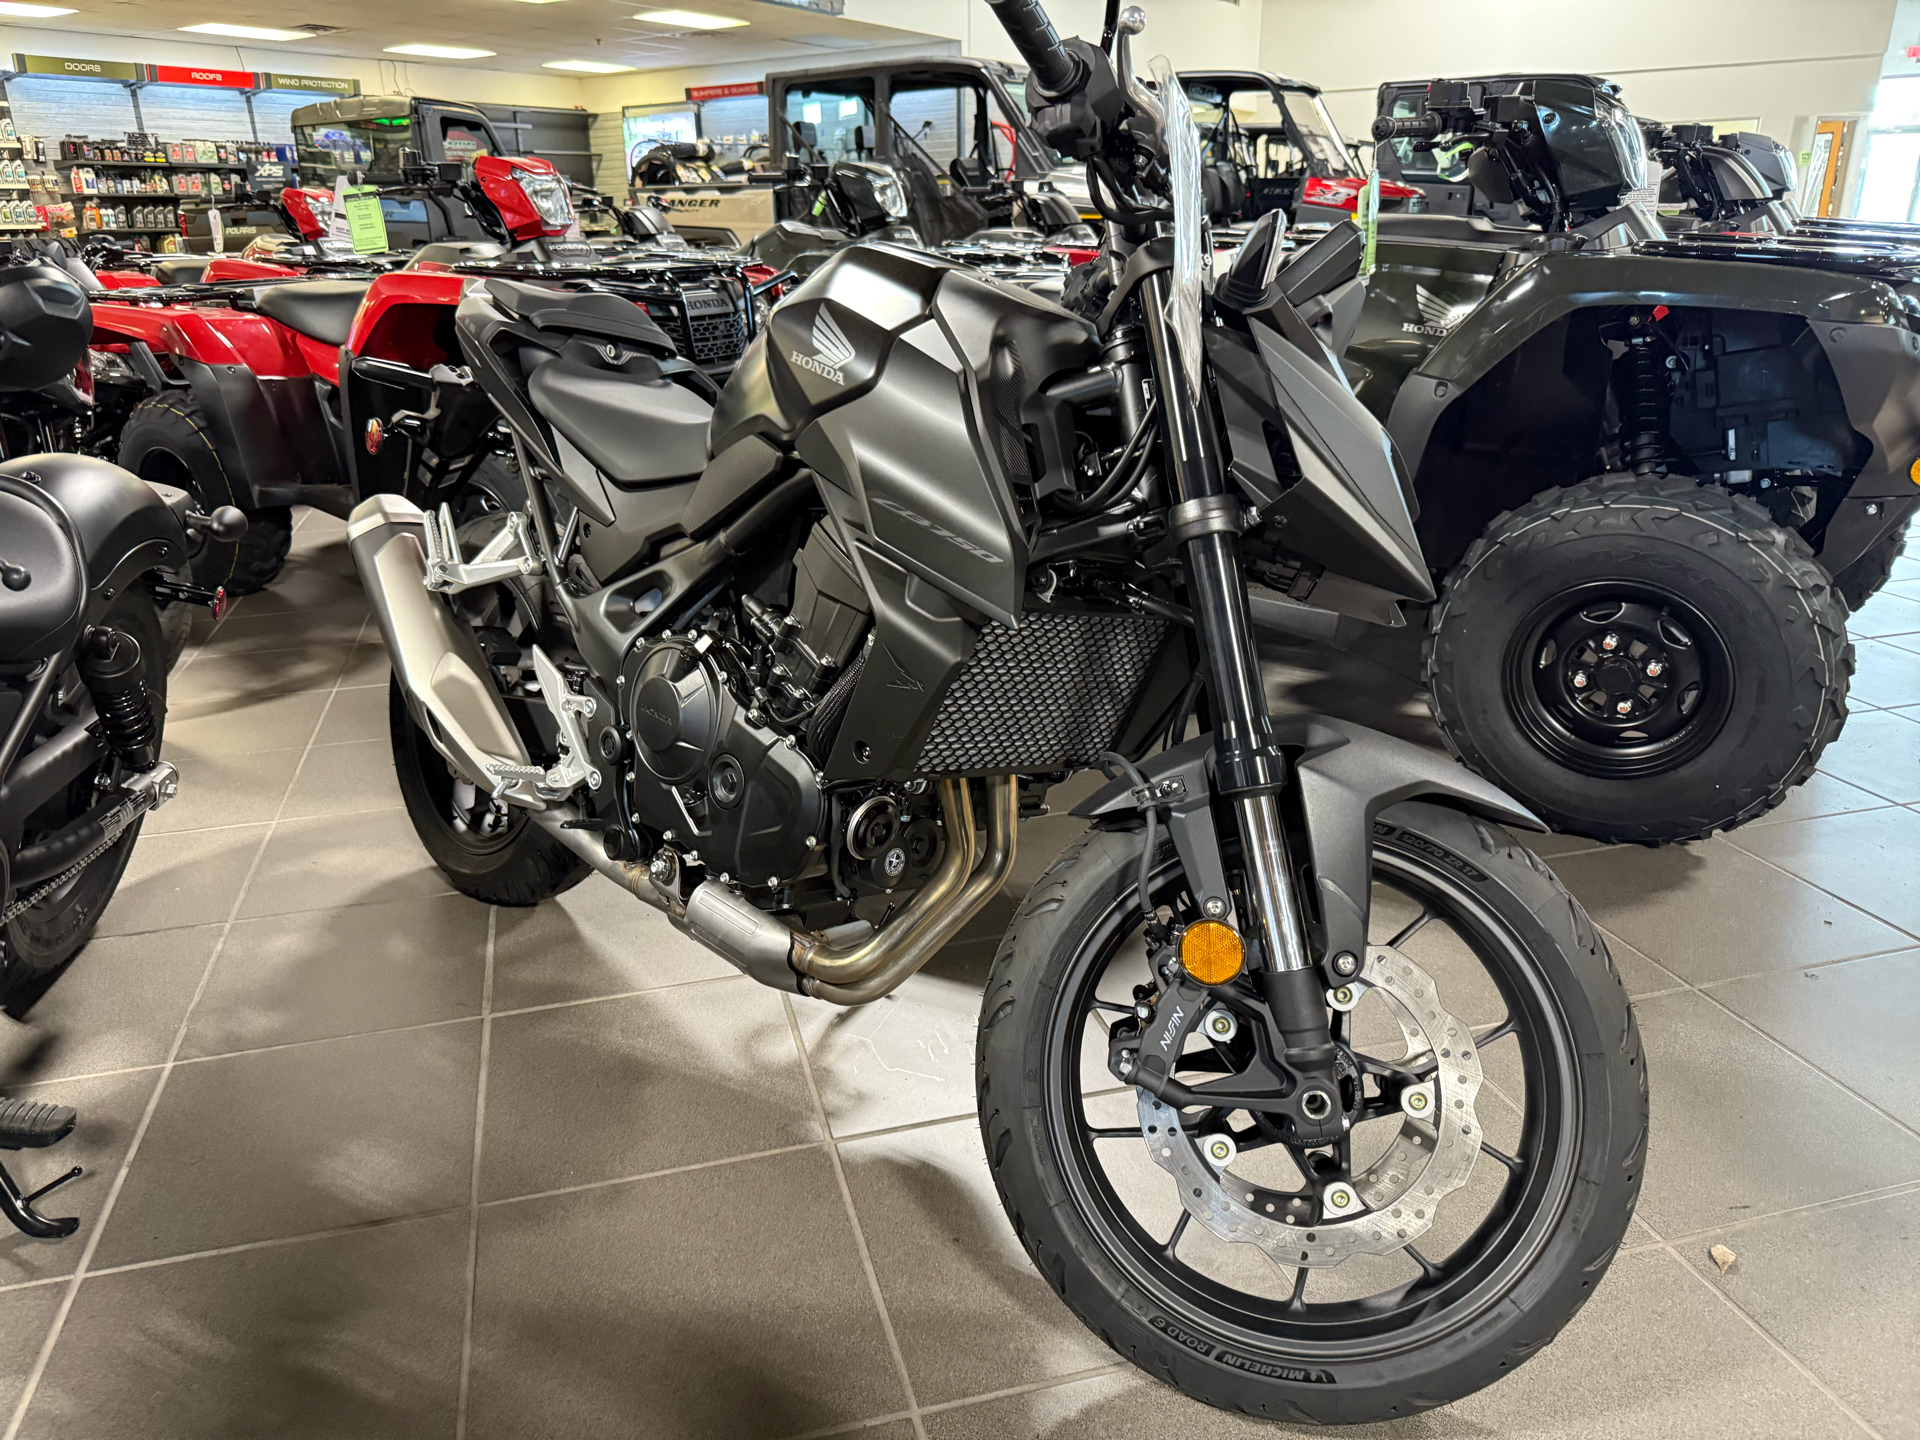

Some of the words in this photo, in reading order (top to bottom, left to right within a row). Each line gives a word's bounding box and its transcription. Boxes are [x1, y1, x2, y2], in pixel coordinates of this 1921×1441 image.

[64, 62, 101, 72] DOORS
[191, 72, 222, 82] ROOFS
[277, 77, 300, 87] WIND
[301, 79, 349, 90] PROTECTION
[254, 163, 284, 176] XPS
[667, 199, 721, 208] ANGER
[225, 226, 257, 235] POLARIS
[687, 298, 730, 311] HONDA
[1401, 322, 1448, 337] HOND
[790, 350, 845, 387] HONDA
[1401, 833, 1445, 858] 120/70
[1443, 854, 1465, 869] ZR
[1462, 866, 1479, 877] 17
[1159, 1005, 1184, 1052] NISSIN
[1152, 1316, 1167, 1328] 6
[1166, 1324, 1210, 1354] ROAD
[1222, 1352, 1306, 1381] MICHELIN
